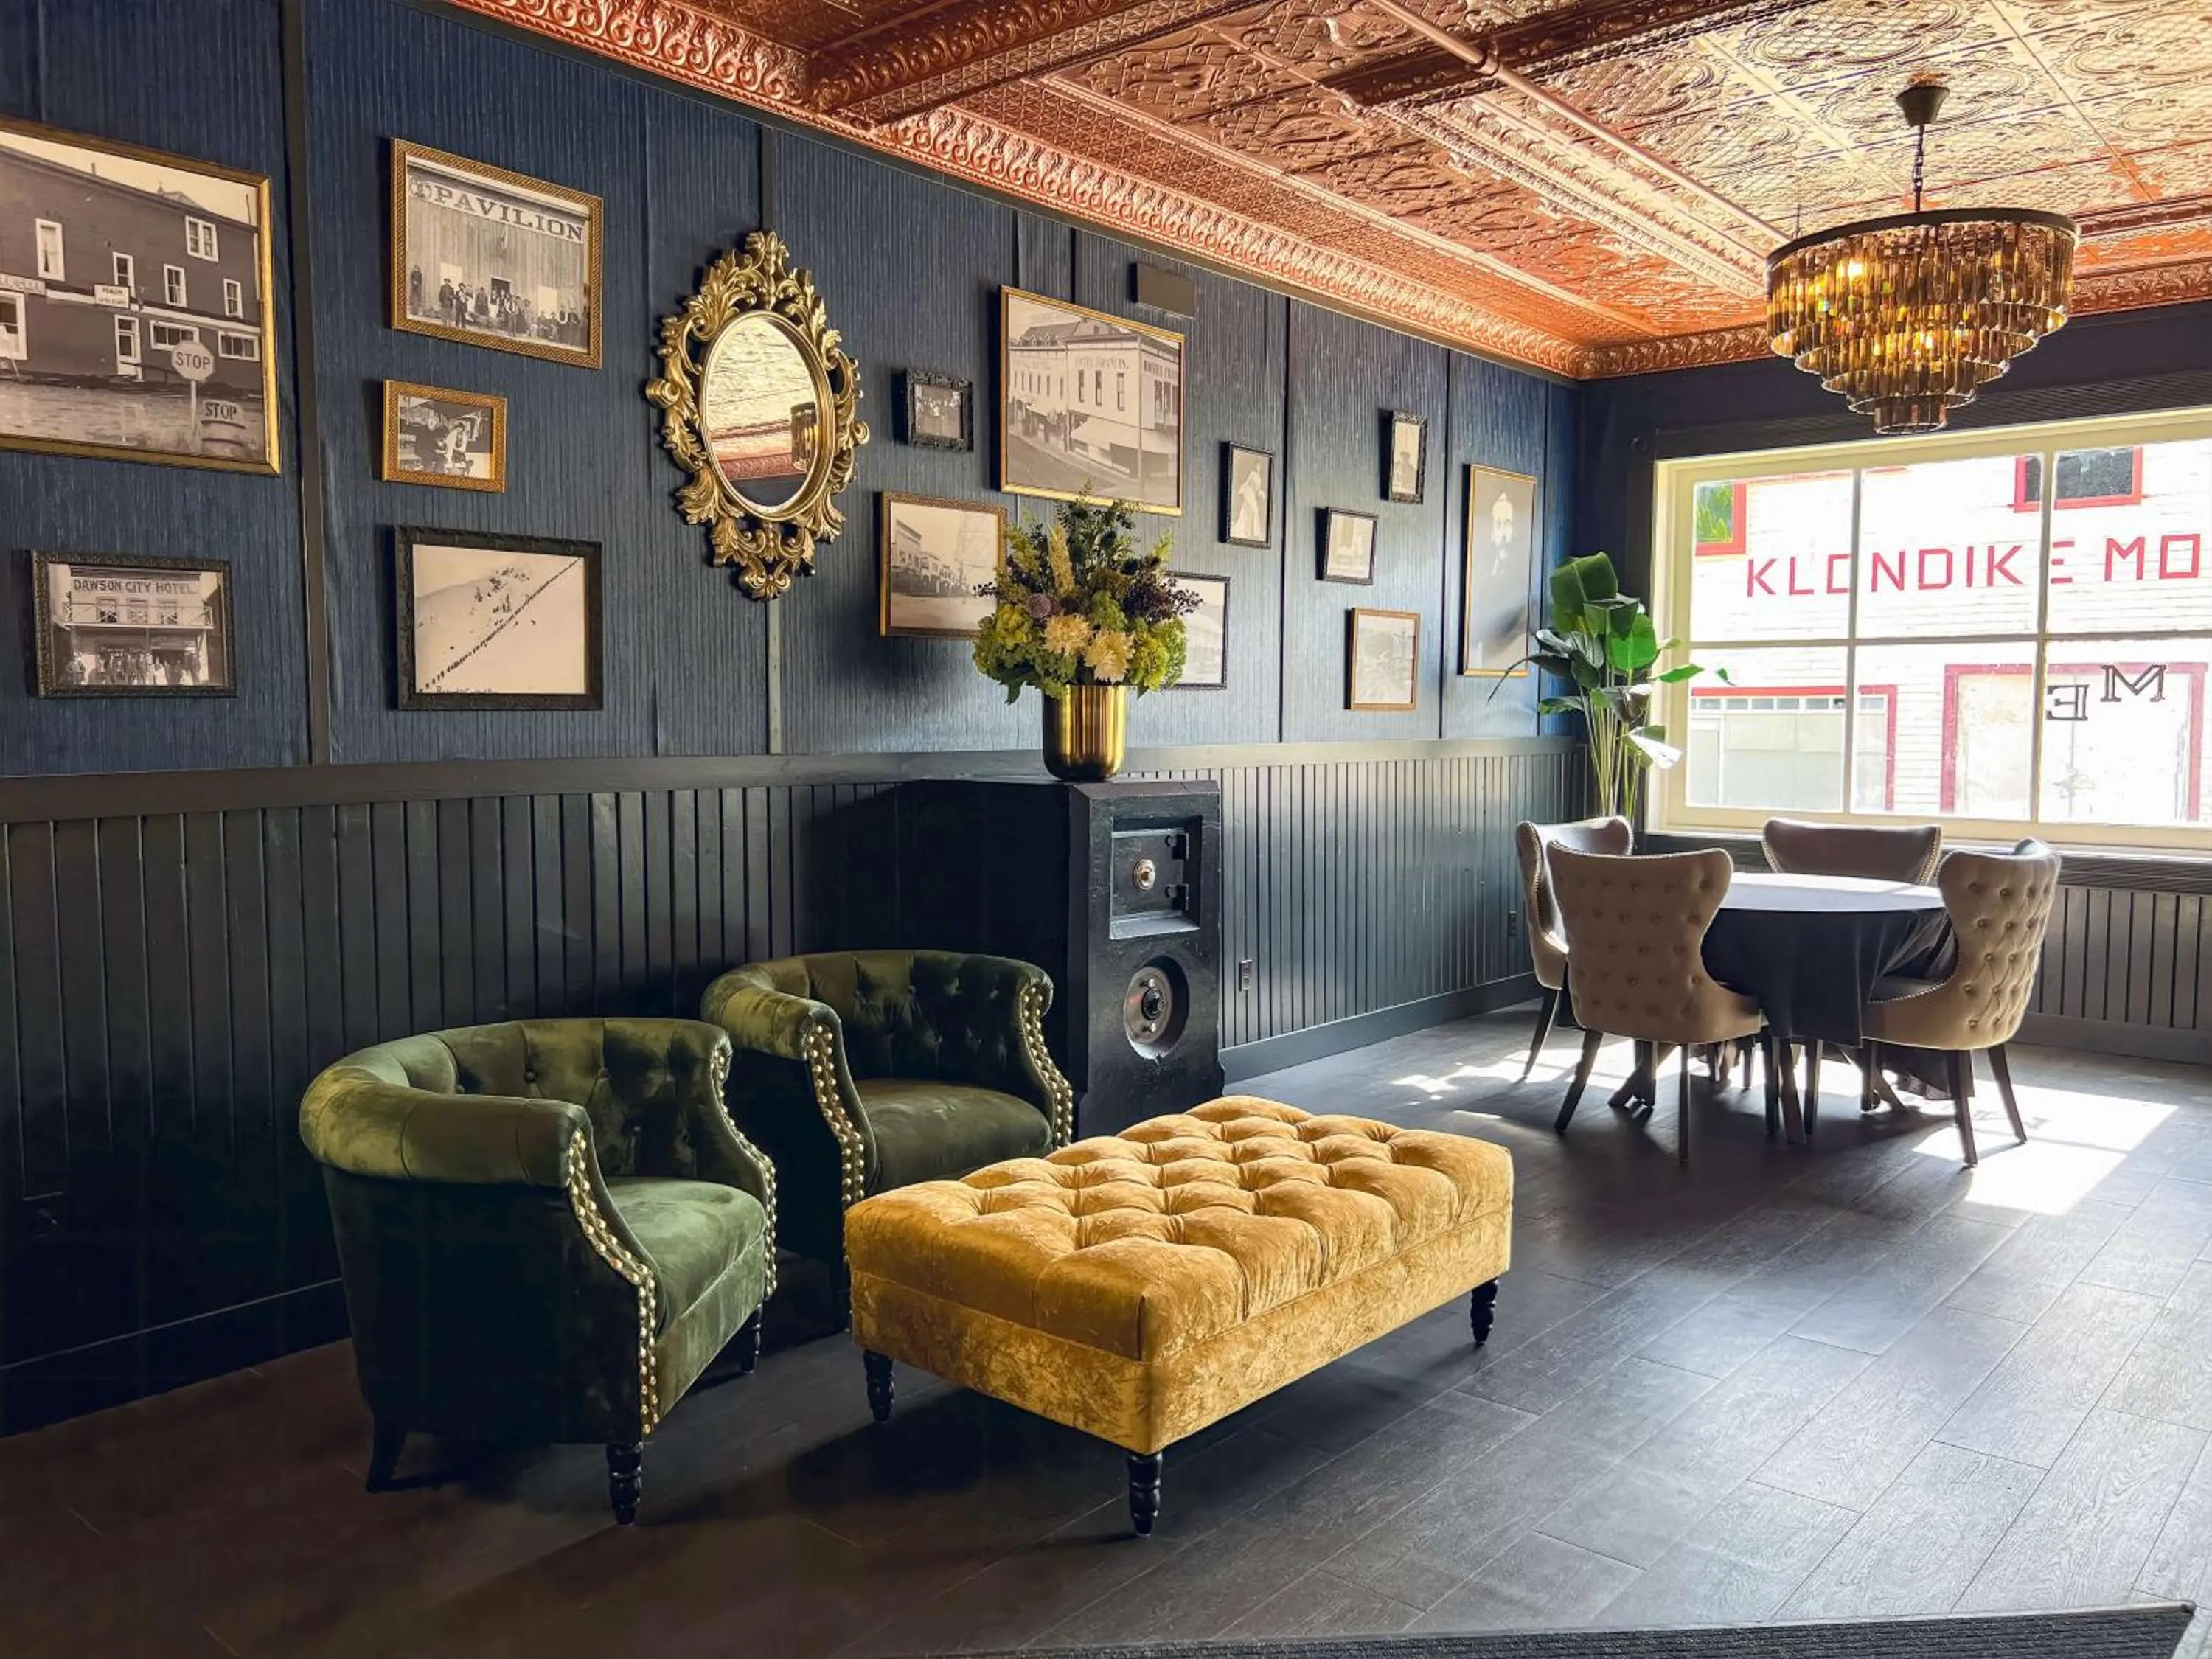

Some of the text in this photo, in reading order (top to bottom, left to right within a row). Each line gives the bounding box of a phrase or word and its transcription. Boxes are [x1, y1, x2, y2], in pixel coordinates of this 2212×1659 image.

[434, 185, 583, 241] PAVILION
[176, 352, 211, 370] STOP
[204, 402, 237, 420] STOP
[73, 579, 198, 595] DAWSON CITY HOTEL
